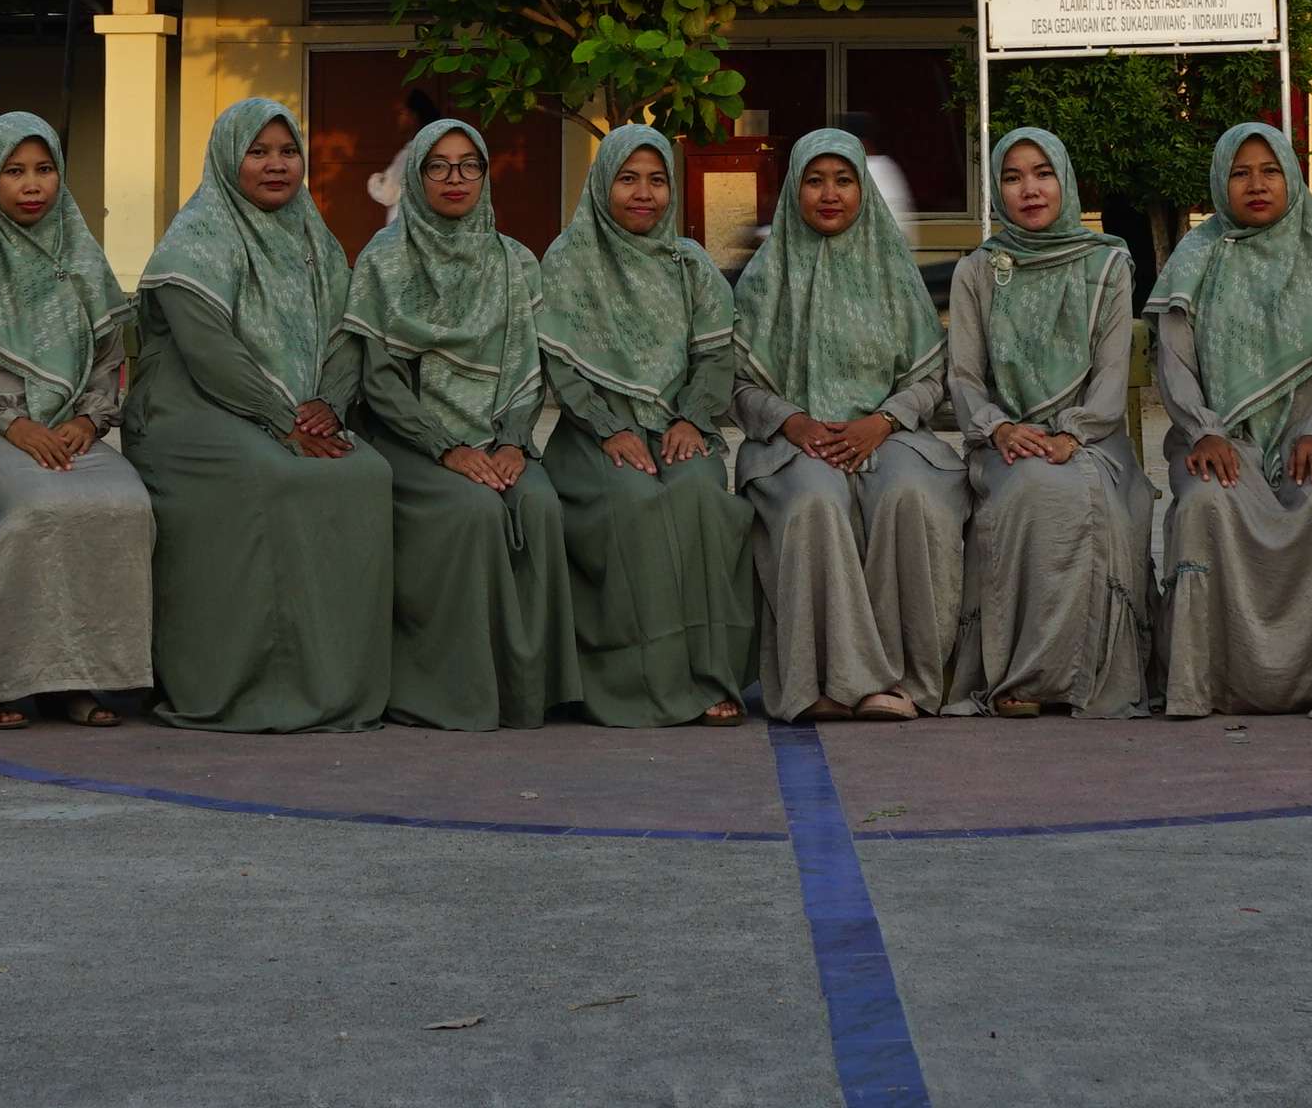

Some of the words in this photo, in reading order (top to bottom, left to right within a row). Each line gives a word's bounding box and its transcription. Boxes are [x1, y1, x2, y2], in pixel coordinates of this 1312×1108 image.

[1031, 18, 1053, 34] DESA
[1054, 17, 1099, 34] GEDANGAN
[1100, 16, 1119, 32] KEC.
[1121, 14, 1186, 32] SUKAGUMIWANG
[1192, 13, 1238, 30] INDRAMAYU
[1240, 12, 1262, 29] 45274
